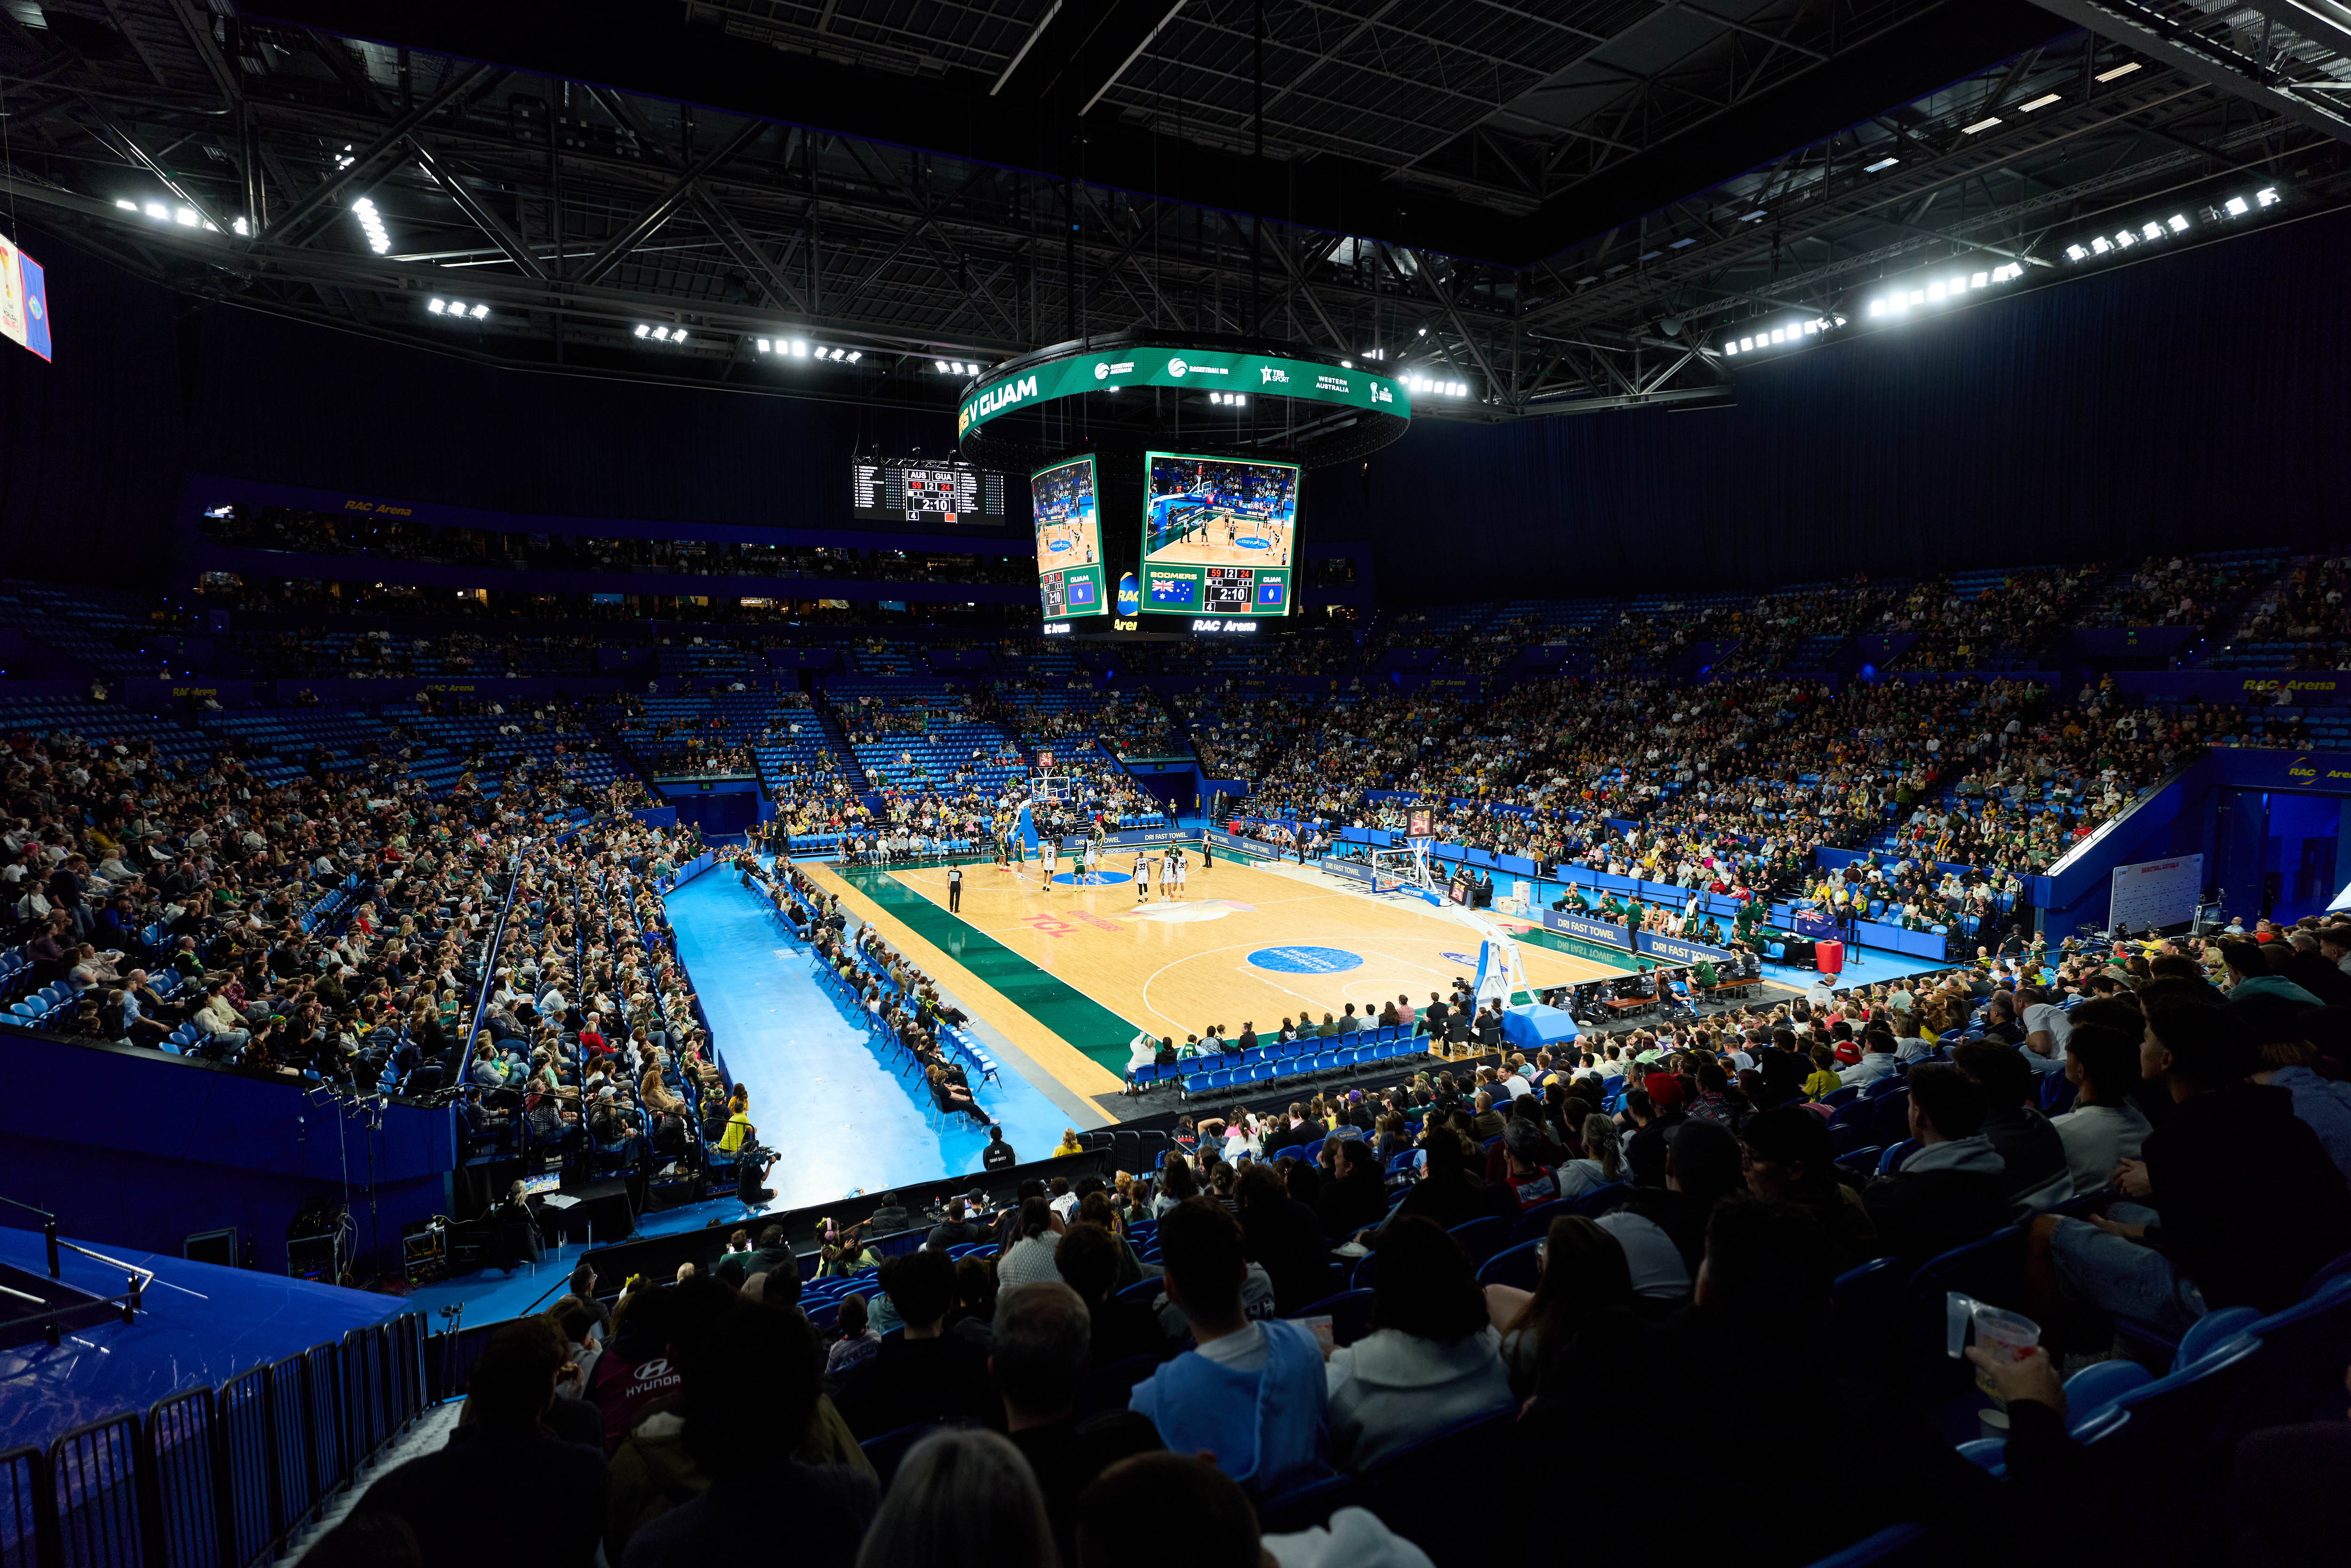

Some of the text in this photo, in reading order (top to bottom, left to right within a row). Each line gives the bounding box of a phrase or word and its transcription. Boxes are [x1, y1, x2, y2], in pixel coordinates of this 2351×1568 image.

[1318, 376, 1347, 386] WESTERN
[1316, 382, 1349, 393] AUSTRALIA
[970, 400, 978, 422] V
[979, 375, 1037, 417] GUAM
[940, 483, 950, 491] 24
[344, 500, 412, 516] RAC Arena
[923, 499, 947, 511] 2:10
[1049, 574, 1053, 583] 2
[1055, 573, 1061, 581] 24
[1150, 571, 1197, 580] BOOMERS
[1211, 569, 1222, 577] 59
[1228, 569, 1234, 578] 2
[1240, 570, 1249, 578] 24
[1070, 575, 1089, 583] GUAM
[1049, 591, 1061, 604] 2:10
[1220, 589, 1245, 600] 2:10
[1193, 620, 1257, 632] RAC Arena
[2242, 680, 2336, 690] RAC Arena
[1041, 758, 1051, 766] 24
[2288, 768, 2316, 776] RAC
[1415, 810, 1429, 819] 2:10
[1412, 819, 1428, 834] 24
[1333, 864, 1343, 872] FAST
[1344, 866, 1361, 876] TOWEL.
[1452, 889, 1462, 900] 24
[1021, 914, 1080, 938] TCL
[1066, 910, 1124, 931] QUALIFIERS
[1558, 918, 1617, 941] DRI FAST TOWEL.
[1652, 941, 1666, 953] DRI
[1669, 944, 1689, 958] FAST
[1270, 950, 1328, 972] AUSTRALIA
[1287, 949, 1340, 969] WESTERN
